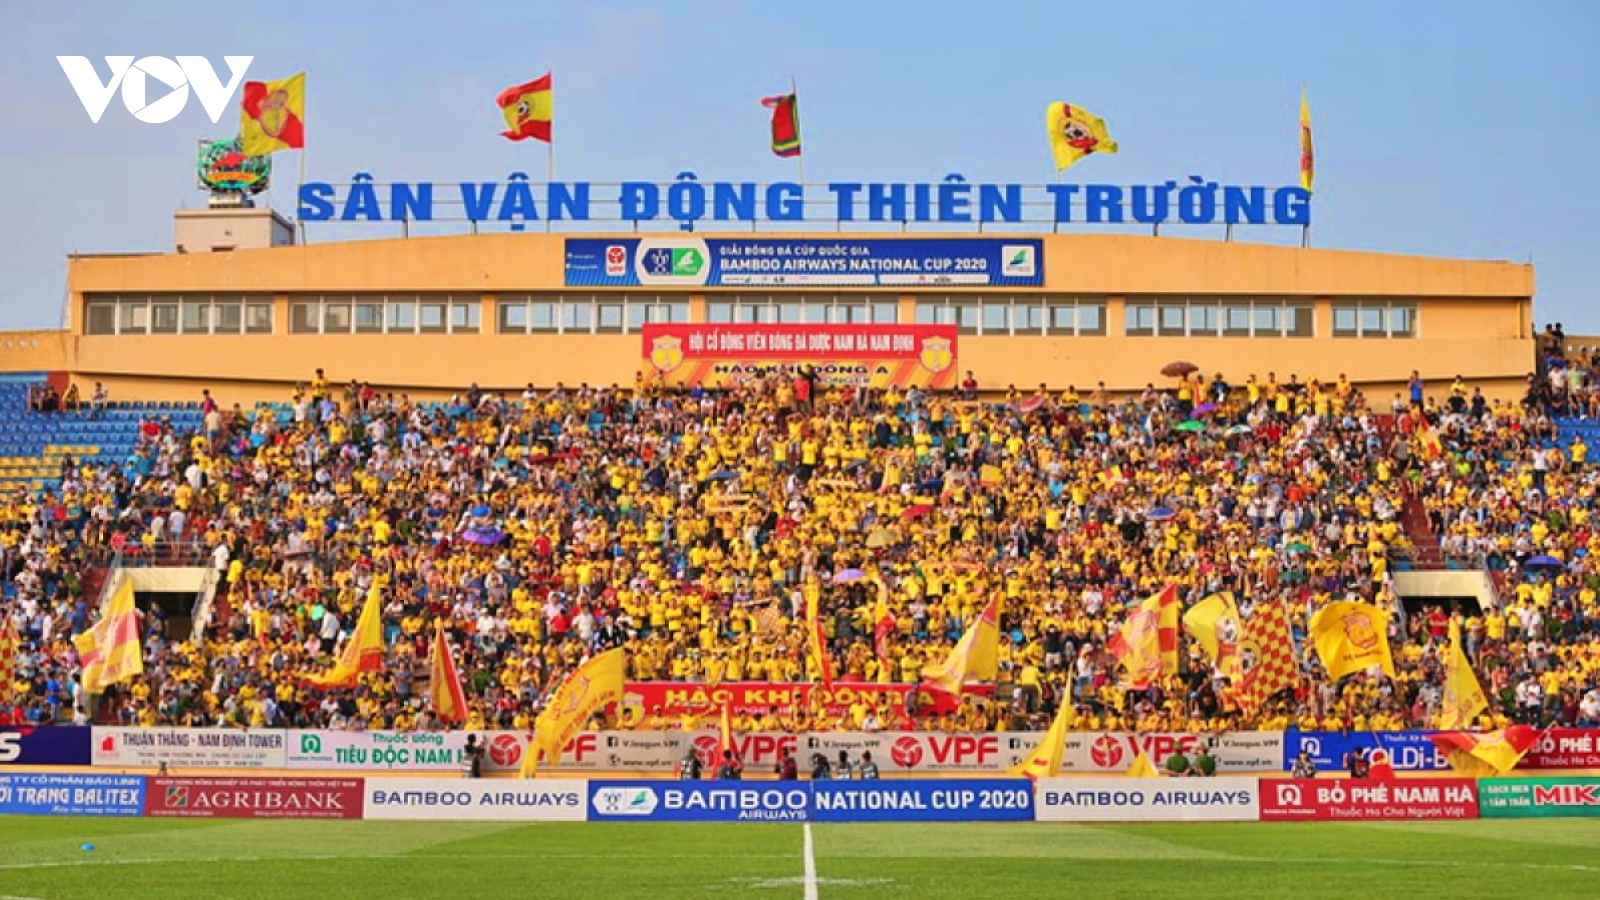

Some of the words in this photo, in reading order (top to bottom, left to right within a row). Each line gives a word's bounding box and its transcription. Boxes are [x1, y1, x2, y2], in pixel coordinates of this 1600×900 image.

[297, 172, 433, 221] SÂN
[459, 171, 590, 231] VẬN
[619, 171, 805, 231] ĐỘNG
[829, 173, 1022, 222] THIÊN
[1046, 175, 1312, 225] TRƯỜNG
[851, 246, 870, 256] GIA
[720, 258, 780, 270] BAMBOO
[783, 258, 846, 270] AIRWAYS
[850, 258, 921, 270] NATIONAL
[924, 258, 952, 270] CUP
[955, 258, 987, 270] 2020
[834, 334, 854, 351] NAM
[870, 334, 891, 351] NAM
[876, 366, 889, 374] A
[198, 733, 220, 748] NAM
[249, 734, 282, 749] TOWER
[416, 748, 453, 764] NAM
[927, 736, 998, 763] VPF
[17, 787, 71, 806] TRANG
[74, 787, 140, 806] BALITEX
[193, 791, 346, 810] AGRIBANK
[372, 790, 472, 806] BAMBOO
[479, 791, 580, 806] AIRWAYS
[664, 789, 807, 811] BAMBOO
[816, 790, 927, 810] NATIONAL
[931, 790, 975, 810] CUP
[978, 790, 1029, 810] 2020
[1045, 791, 1144, 806] BAMBOO
[1152, 791, 1252, 806] AIRWAYS
[1352, 782, 1388, 803] PHẾ
[1394, 787, 1439, 803] NAM
[1445, 784, 1475, 803] HÀ
[739, 810, 807, 820] AIRWAYS
